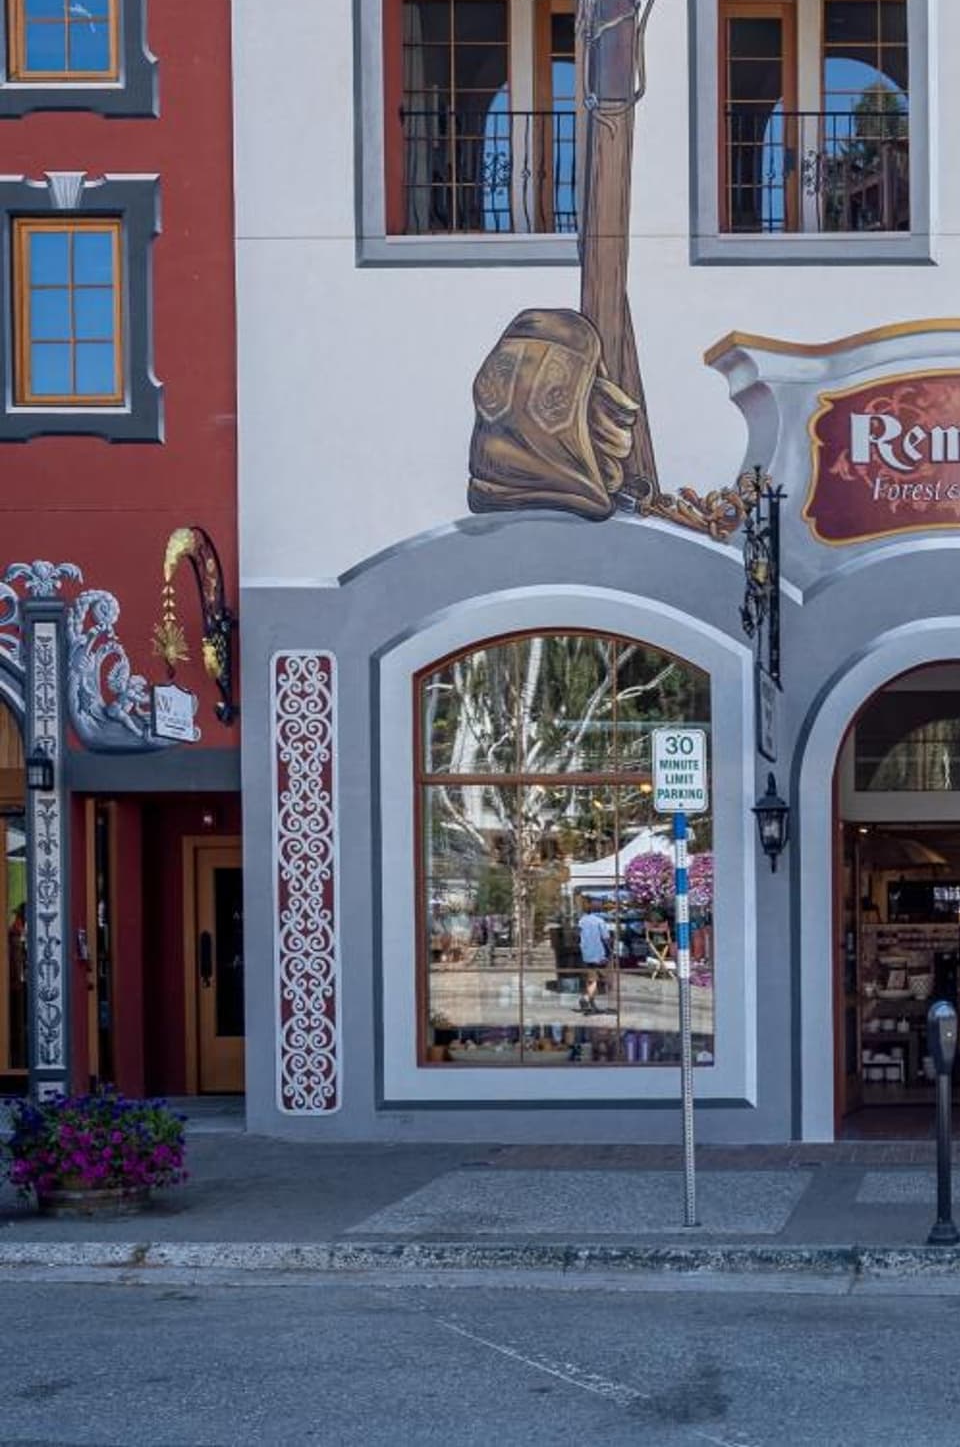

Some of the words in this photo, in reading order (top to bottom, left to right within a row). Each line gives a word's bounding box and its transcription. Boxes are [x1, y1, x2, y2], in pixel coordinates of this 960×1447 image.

[873, 477, 942, 501] Forest
[666, 737, 693, 754] 30
[660, 760, 699, 770] MINUTE
[665, 775, 694, 784] LIMIT
[657, 789, 703, 799] PARKING
